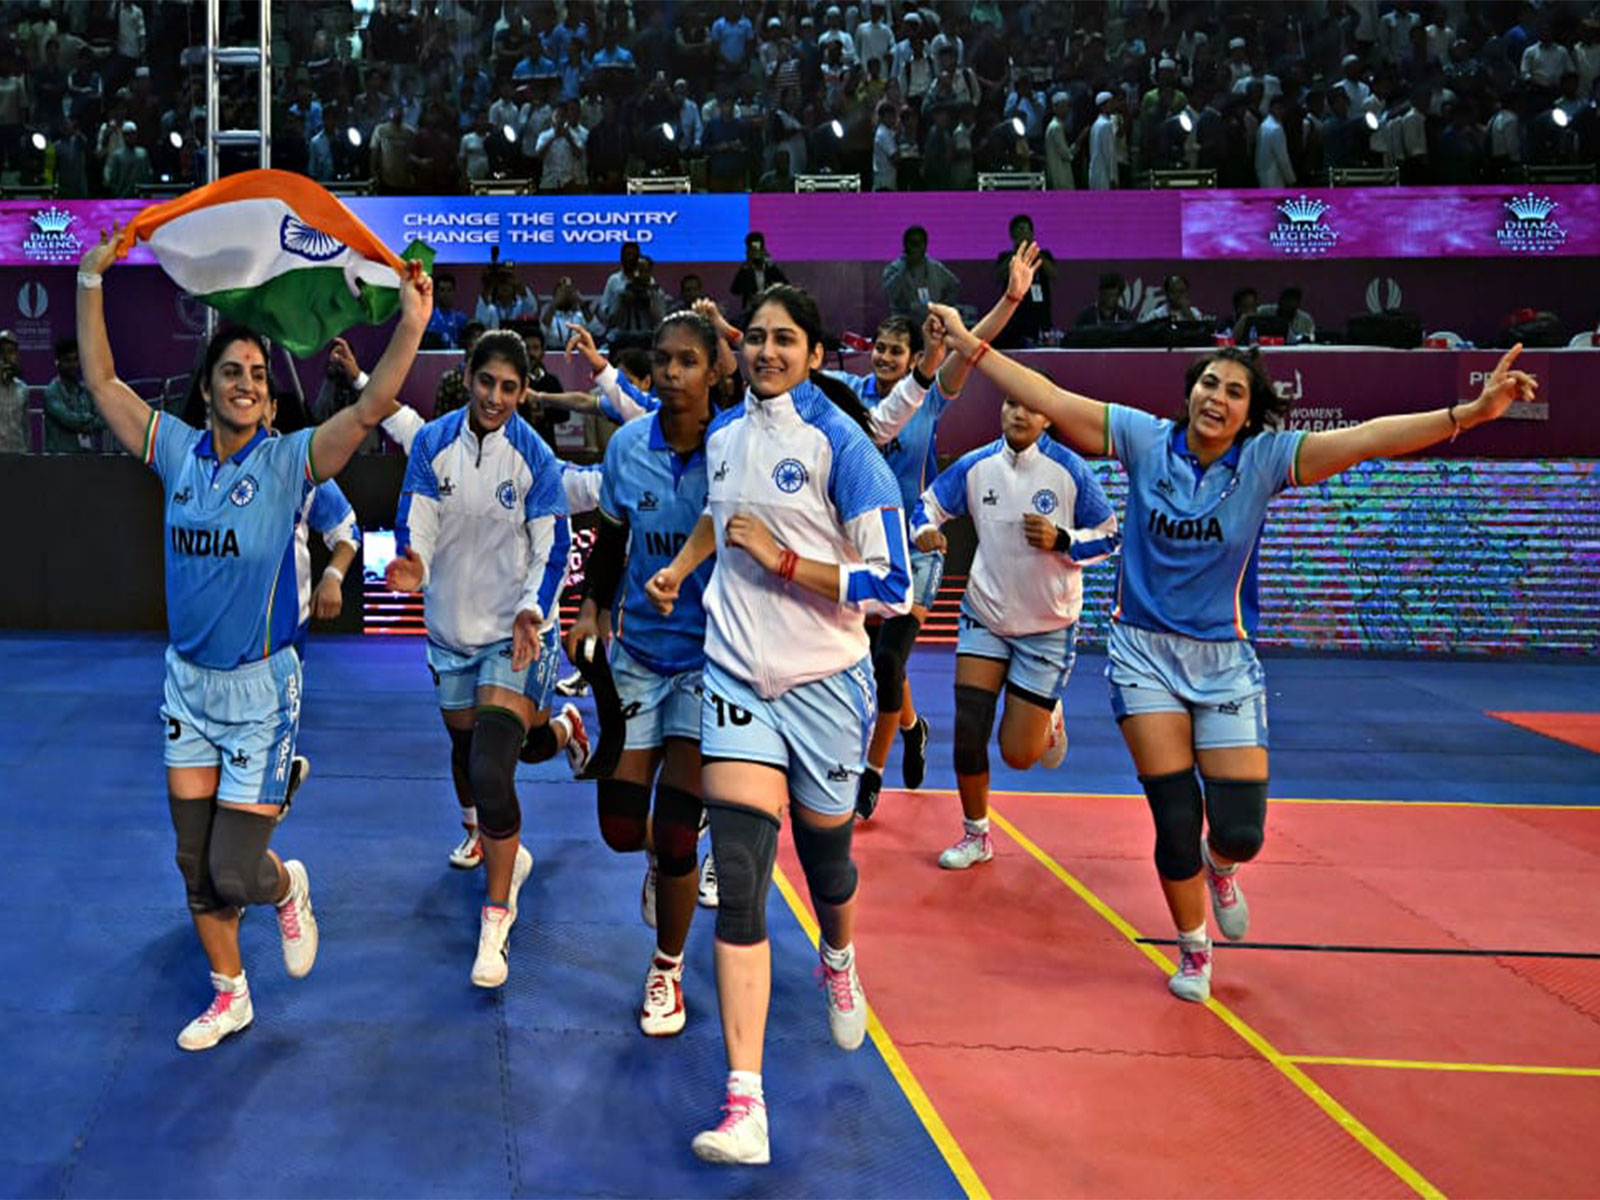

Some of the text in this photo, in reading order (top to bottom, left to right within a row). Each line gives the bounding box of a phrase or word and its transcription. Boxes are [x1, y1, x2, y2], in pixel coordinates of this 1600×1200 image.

[403, 211, 678, 226] CHANGE THE COUNTRY
[403, 229, 653, 244] CHANGE THE WORLD
[1148, 508, 1224, 542] INDIA
[171, 525, 240, 557] INDIA
[645, 531, 688, 557] IND
